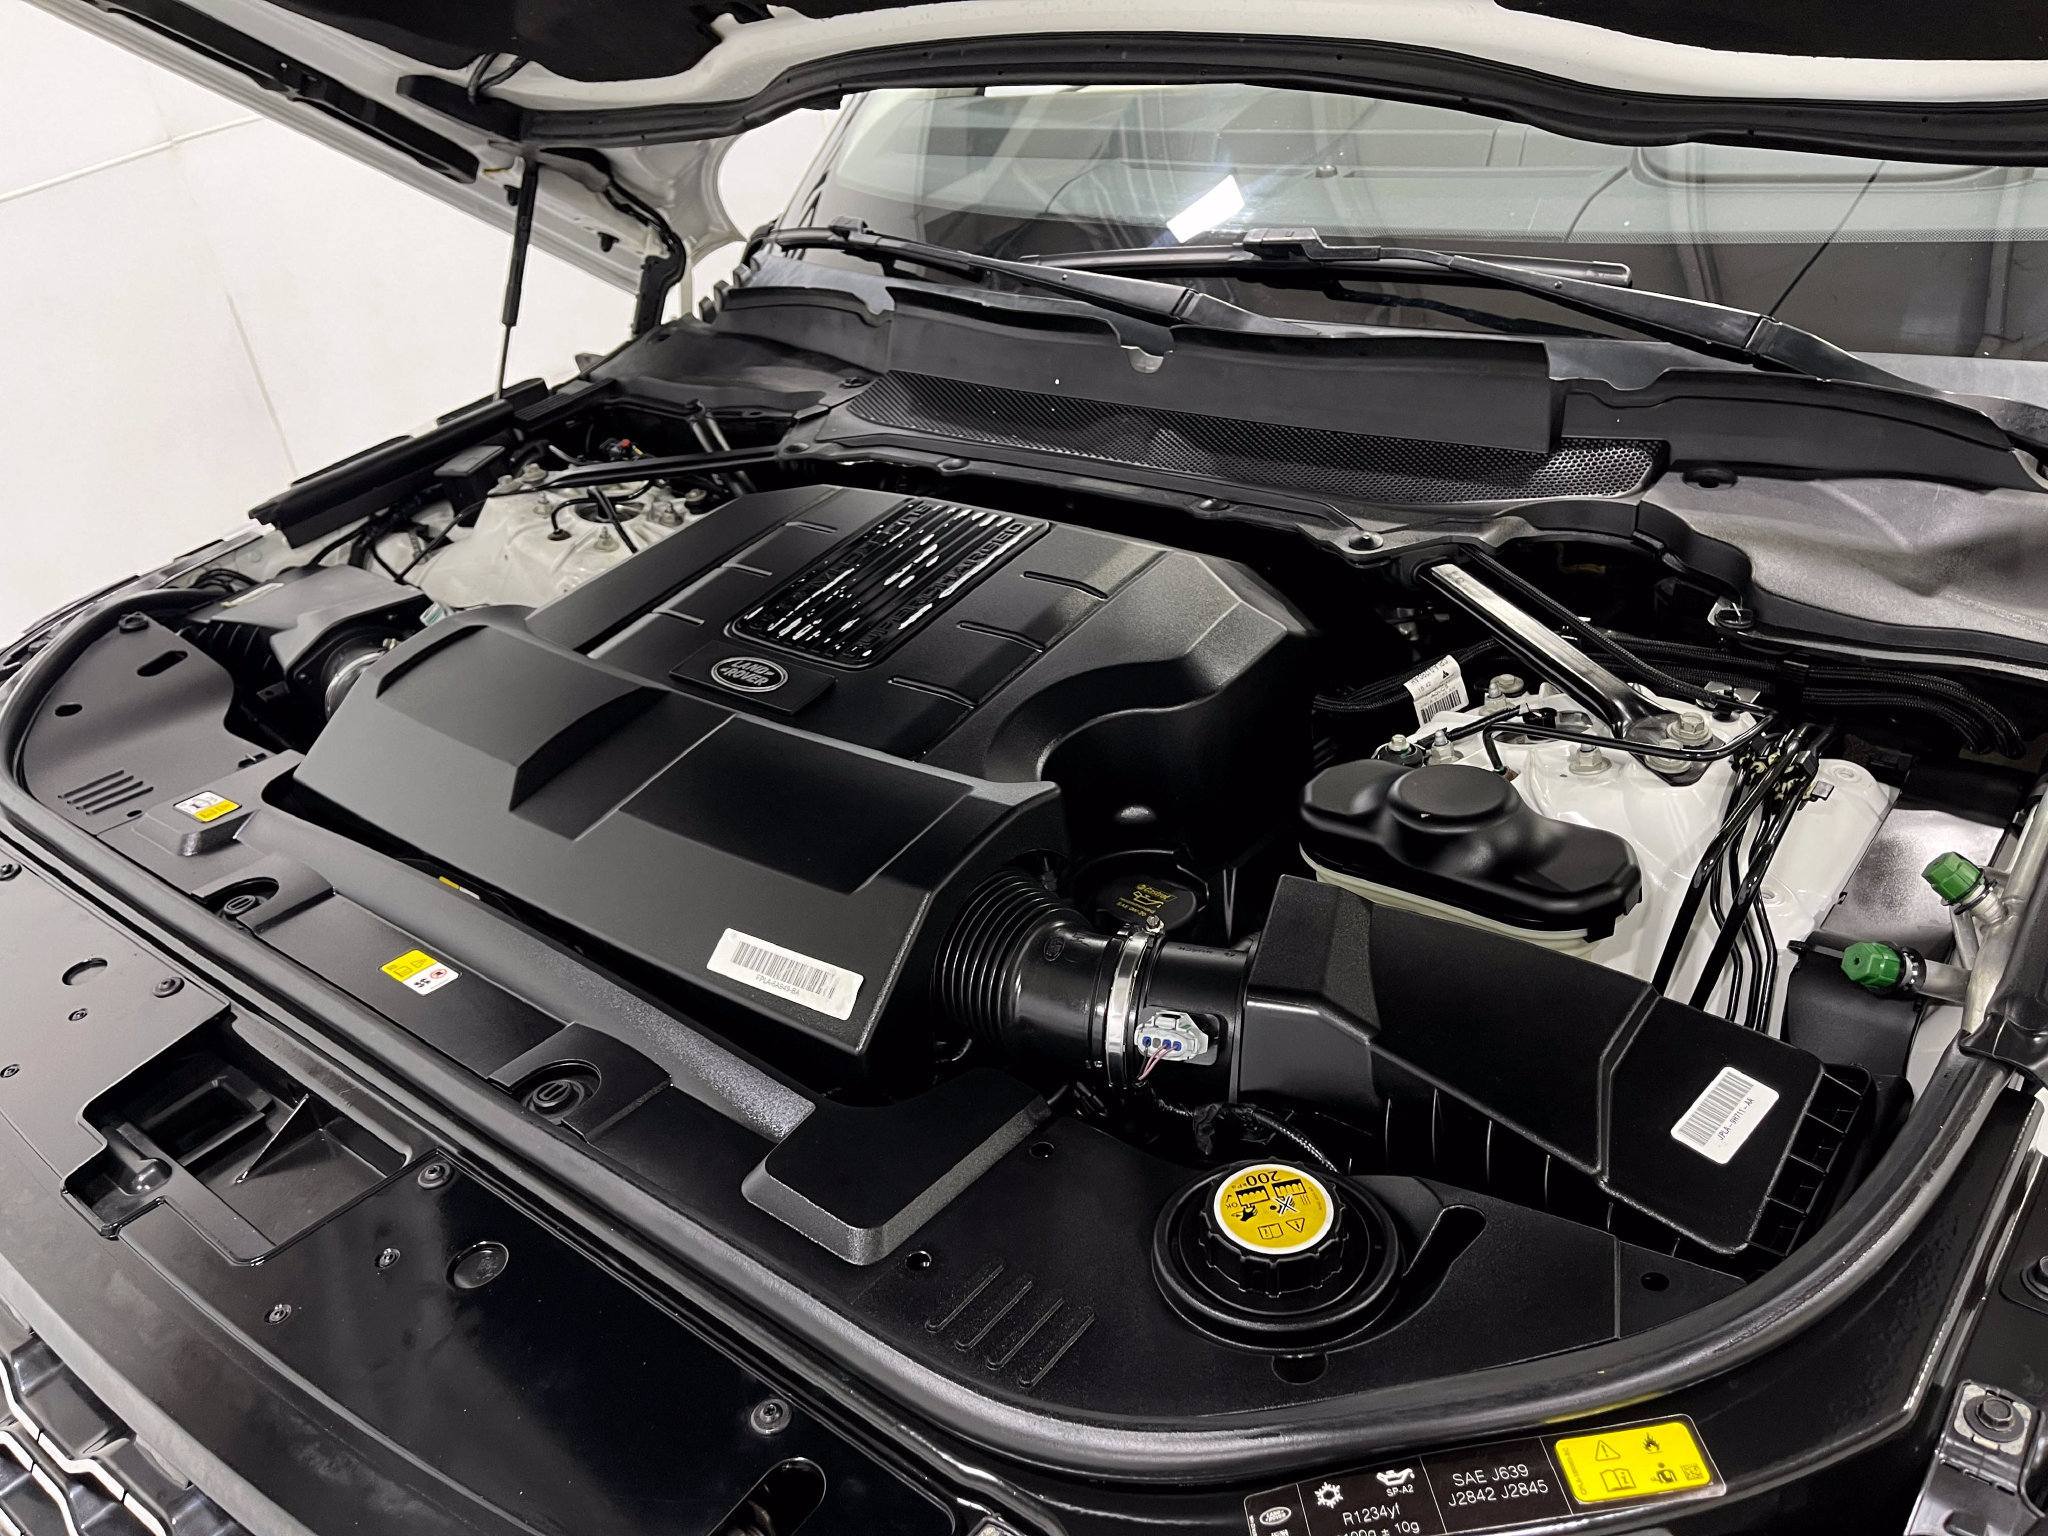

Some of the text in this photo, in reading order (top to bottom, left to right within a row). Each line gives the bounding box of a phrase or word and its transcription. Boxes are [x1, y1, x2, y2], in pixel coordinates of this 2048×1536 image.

[731, 660, 769, 675] LAND
[724, 668, 769, 686] ROVER
[1246, 1170, 1281, 1187] 200
[1226, 1202, 1239, 1210] OK
[1452, 1463, 1529, 1487] SAE J639
[1386, 1484, 1414, 1498] SP-A2
[1448, 1480, 1549, 1507] J2842 J2845
[1394, 1520, 1421, 1534] 10g
